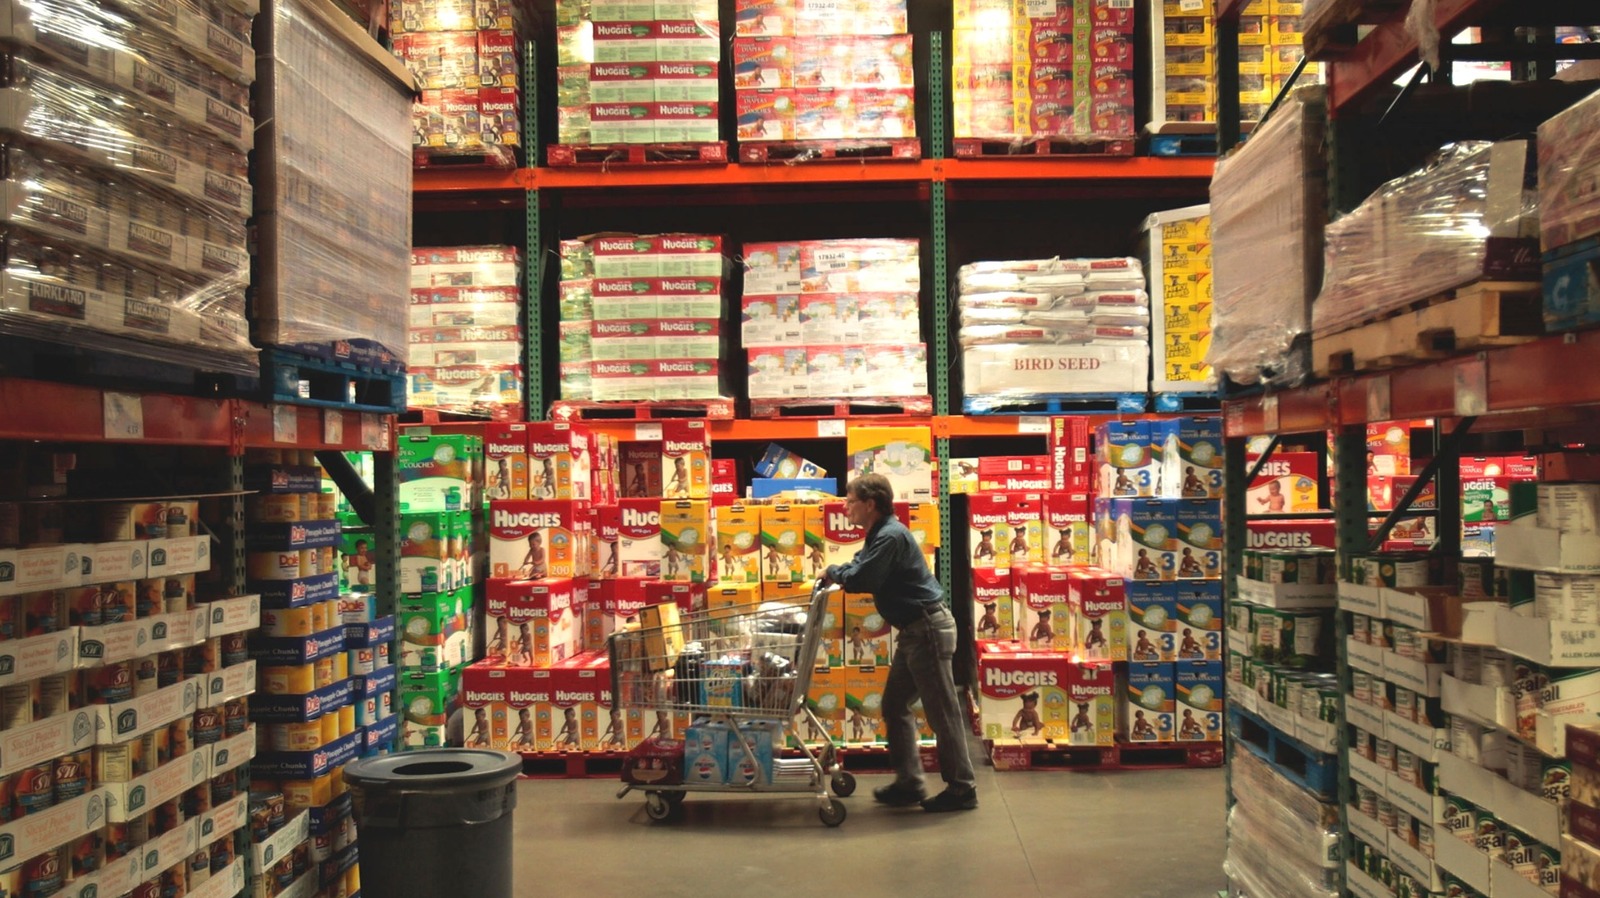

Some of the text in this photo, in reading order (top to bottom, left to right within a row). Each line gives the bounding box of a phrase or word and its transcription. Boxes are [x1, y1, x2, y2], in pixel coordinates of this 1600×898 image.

[598, 26, 632, 36] HUGGIES
[661, 24, 696, 34] HUGGIES
[481, 44, 513, 54] HUGGIES
[595, 67, 630, 76] HUGGIES
[660, 65, 694, 75] HUGGIES
[483, 102, 514, 112] HUGGIES
[596, 107, 630, 116] HUGGIES
[660, 105, 694, 115] HUGGIES
[130, 222, 172, 248] KIRKLAND
[600, 241, 634, 251] HUGGIES
[663, 239, 697, 250] HUGGIES
[456, 250, 502, 264] HUGGIES
[599, 281, 632, 292] HUGGIES
[661, 280, 696, 291] HUGGIES
[32, 282, 85, 306] KIRKLAND
[127, 299, 170, 321] KIRKLAND
[597, 322, 631, 334] HUGGIES
[660, 321, 694, 332] HUGGIES
[461, 328, 507, 341] HUGGIES
[596, 363, 631, 374] HUGGIES
[659, 362, 694, 373] HUGGIES
[1014, 358, 1101, 371] BIRD SEED
[436, 368, 480, 381] HUGGIES
[489, 443, 524, 453] HUGGIES
[533, 443, 569, 453] HUGGIES
[666, 441, 704, 451] HUGGIES
[804, 464, 817, 476] 3
[1054, 446, 1066, 490] HUGGIES
[1138, 469, 1152, 488] 3
[1208, 469, 1223, 488] 3
[712, 483, 734, 493] GIES
[1007, 479, 1051, 490] HUGGIES
[1463, 481, 1496, 490] UGGIES
[494, 510, 561, 528] HUGGIES
[972, 514, 1007, 524] HUGGIES
[1008, 511, 1040, 521] HUGGIES
[1051, 513, 1086, 522] HUGGIES
[291, 525, 305, 541] Dole
[1160, 551, 1175, 571] 3
[1205, 551, 1219, 570] 3
[551, 565, 570, 576] 200
[293, 582, 305, 598] Dole
[976, 587, 1010, 597] HUGGIES
[1029, 592, 1066, 603] HUGGIES
[343, 600, 365, 612] Dole
[1085, 601, 1123, 612] HUGGIES
[510, 607, 548, 618] HUGGIES
[1160, 633, 1175, 652] 3
[1205, 632, 1220, 650] 3
[986, 668, 1058, 686] HUGGIES
[1071, 685, 1111, 695] HUGGIES
[466, 691, 505, 701] HUGGIES
[510, 691, 549, 702] HUGGIES
[556, 691, 595, 701] HUGGIES
[306, 695, 320, 713] Dole
[1158, 713, 1173, 732] 3
[1206, 712, 1220, 731] 3
[991, 726, 998, 735] 3
[1046, 726, 1065, 736] 224
